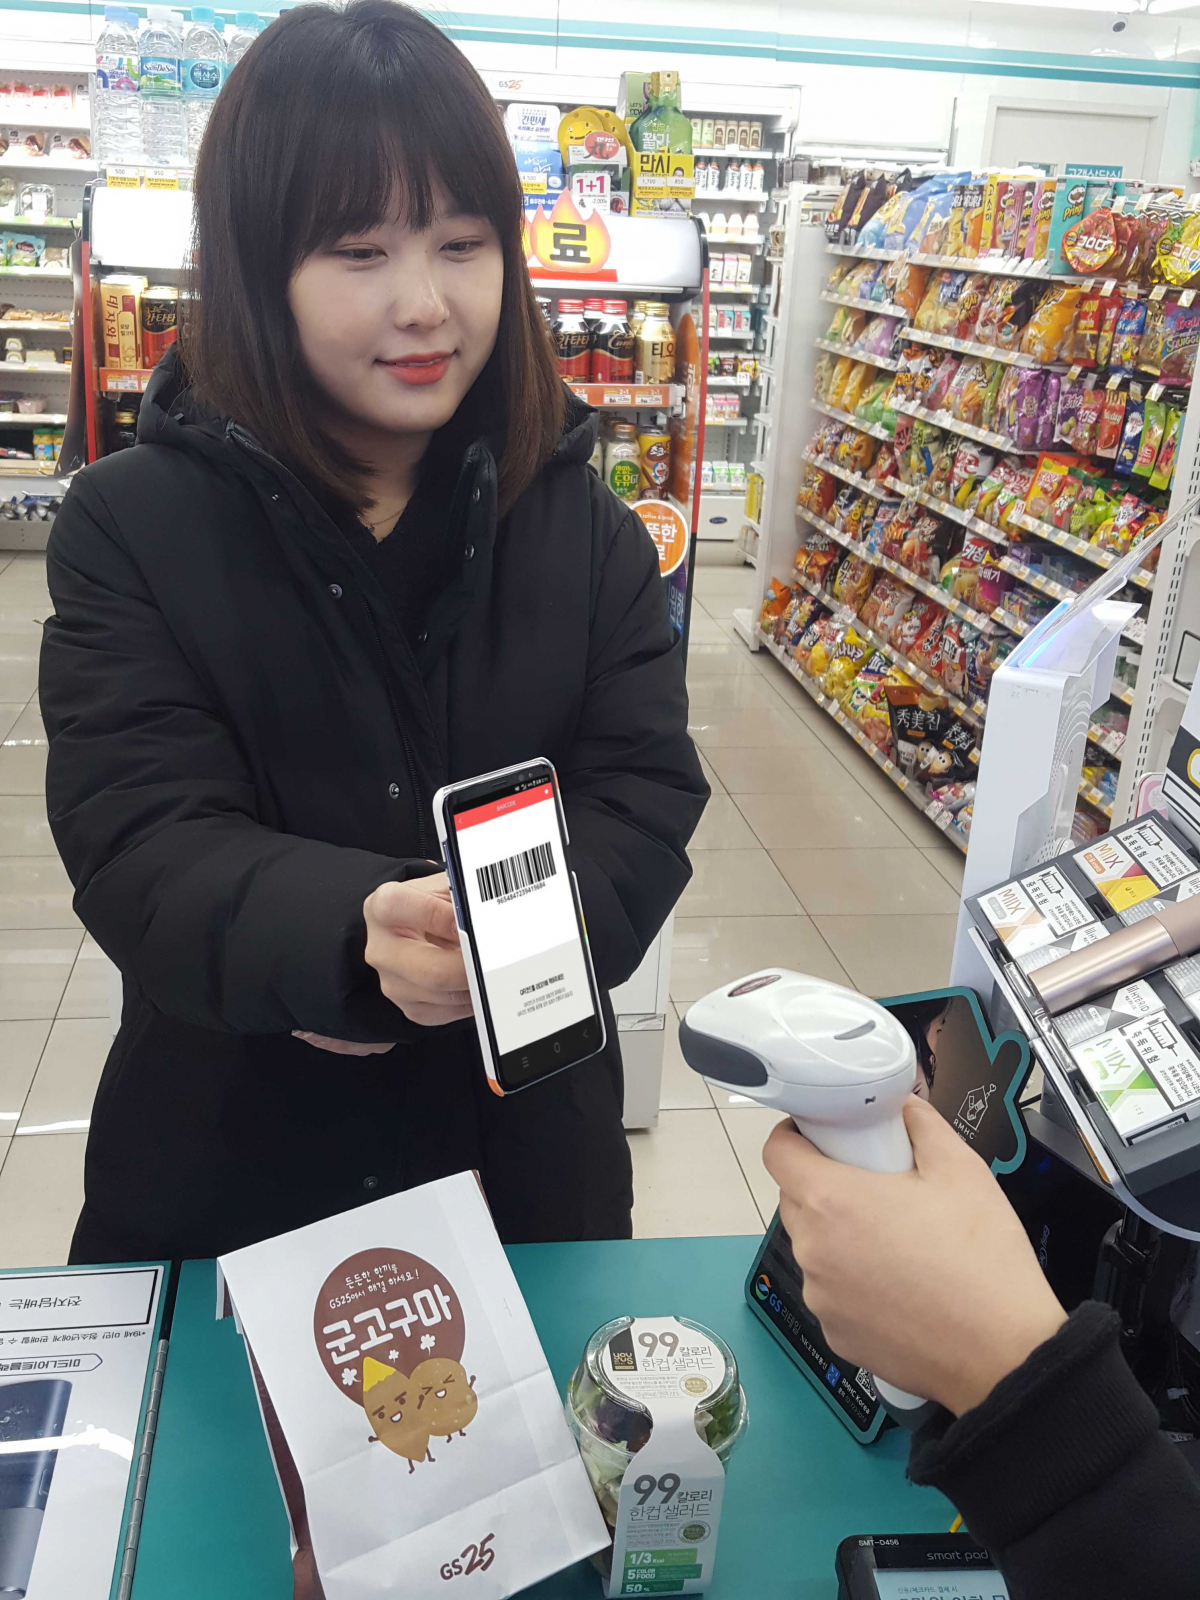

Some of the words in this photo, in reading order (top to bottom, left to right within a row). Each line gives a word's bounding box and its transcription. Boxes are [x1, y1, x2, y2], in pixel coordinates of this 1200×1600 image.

[193, 70, 218, 81] 백산수
[498, 80, 523, 91] GS25
[576, 175, 605, 194] 1+1
[985, 184, 995, 222] 고소미
[549, 222, 591, 264] 료
[145, 306, 177, 326] 칸타타
[1166, 335, 1200, 353] SQUIGGL
[614, 474, 631, 486] 두유
[646, 522, 678, 543] 뜻한
[496, 799, 516, 812] BARCODE
[953, 1118, 976, 1140] RMHC
[345, 1270, 371, 1289] 든든한
[373, 1263, 399, 1278] 한끼를
[8, 1295, 82, 1309] 전자담배는
[329, 1290, 366, 1309] GS25에서
[367, 1282, 388, 1293] 해결
[769, 1293, 782, 1313] GS
[322, 1283, 452, 1365] 군고구마
[52, 1332, 98, 1343] 청소년에게
[102, 1331, 121, 1340] 미만
[637, 1332, 680, 1357] 99
[679, 1345, 712, 1357] 칼로리
[641, 1357, 671, 1371] 한컵
[672, 1357, 716, 1371] 샐러드
[841, 1377, 857, 1398] RMHC
[855, 1395, 870, 1415] Korea
[633, 1473, 681, 1506] 99
[677, 1489, 713, 1503] 칼로리
[629, 1505, 661, 1521] 한컵
[664, 1503, 711, 1520] 샐러드
[858, 1538, 900, 1547] SMT-D456
[440, 1532, 495, 1581] GS25
[629, 1552, 652, 1565] 1/3
[926, 1551, 962, 1562] smart
[964, 1549, 989, 1563] pad
[627, 1569, 636, 1580] 5
[625, 1583, 643, 1593] 50
